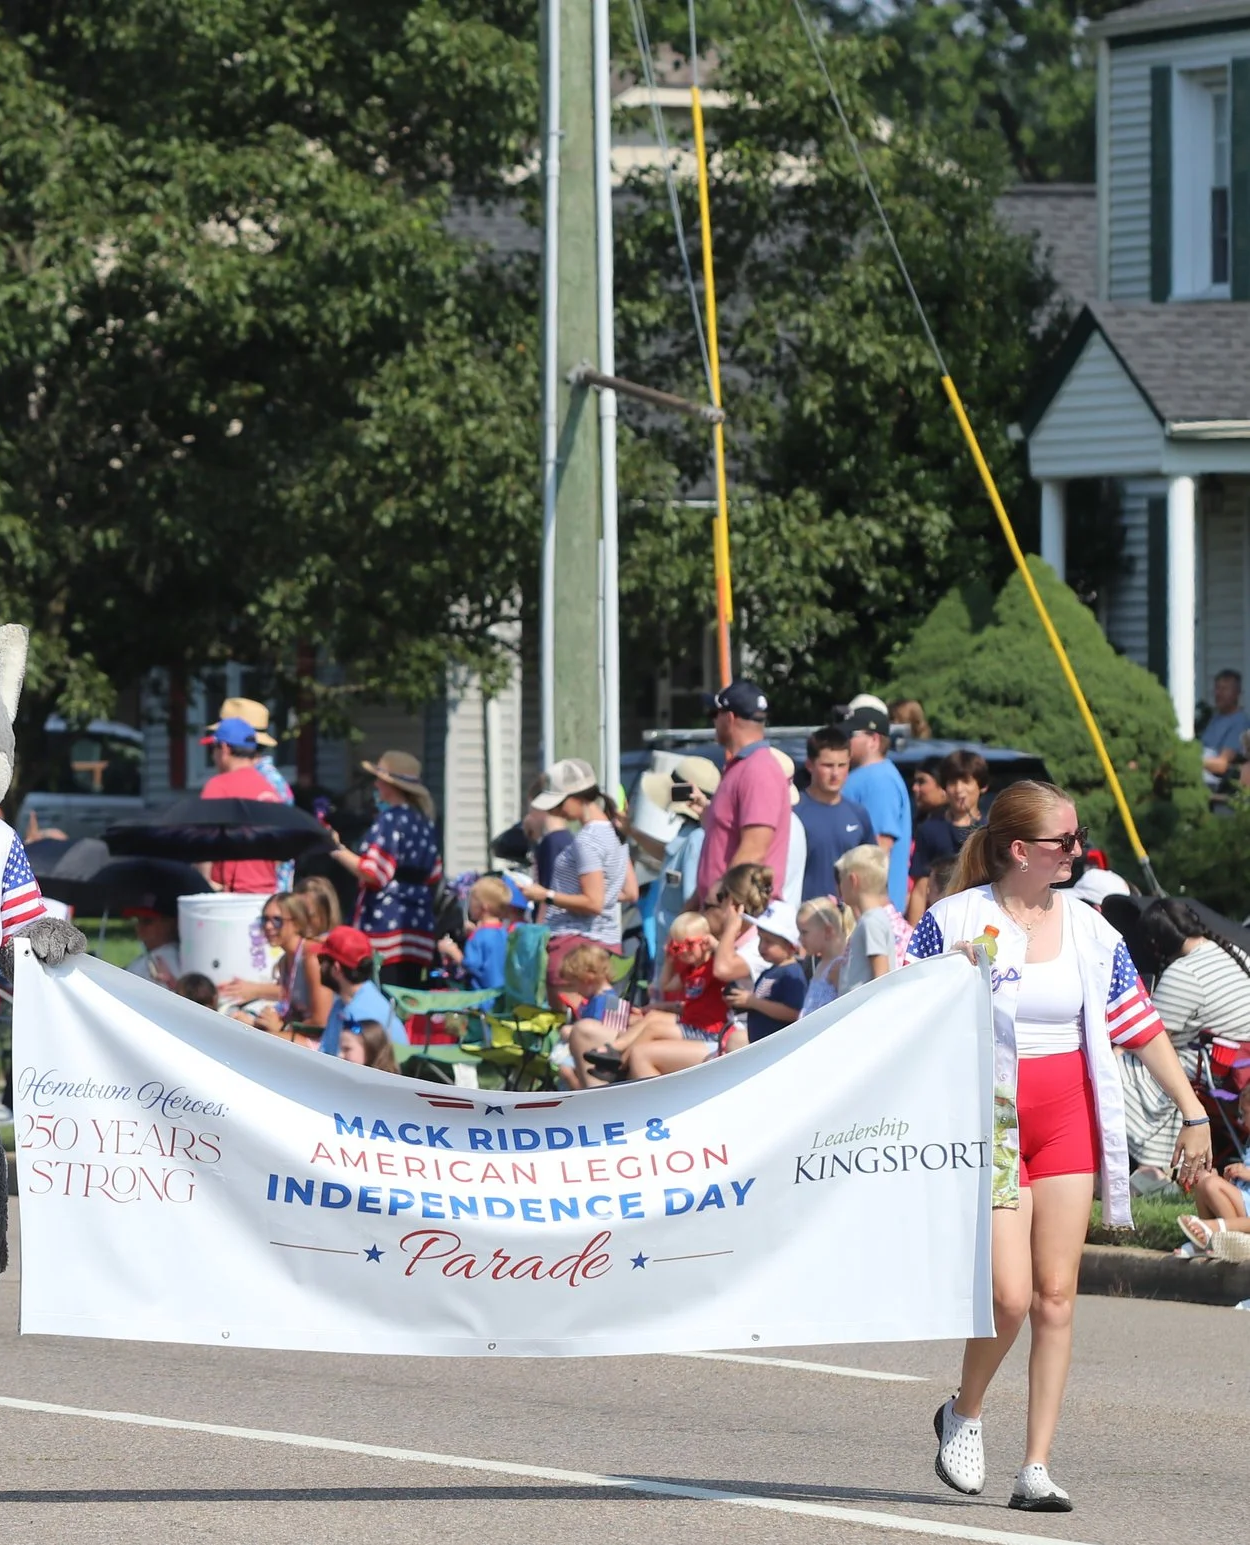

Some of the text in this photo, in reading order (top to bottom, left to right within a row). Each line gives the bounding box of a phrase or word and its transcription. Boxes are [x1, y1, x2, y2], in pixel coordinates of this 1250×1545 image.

[17, 1066, 230, 1120] Hometown Heroes:
[17, 1113, 223, 1164] 250 YEARS
[333, 1112, 671, 1152] MACK RIDDLE &
[812, 1117, 910, 1150] Leadership
[29, 1159, 196, 1204] STRONG
[310, 1142, 730, 1184] AMERICAN LEGION
[793, 1140, 990, 1185] KINGSPORT
[266, 1173, 757, 1224] INDEPENDENCE DAY
[399, 1230, 614, 1288] Parade
